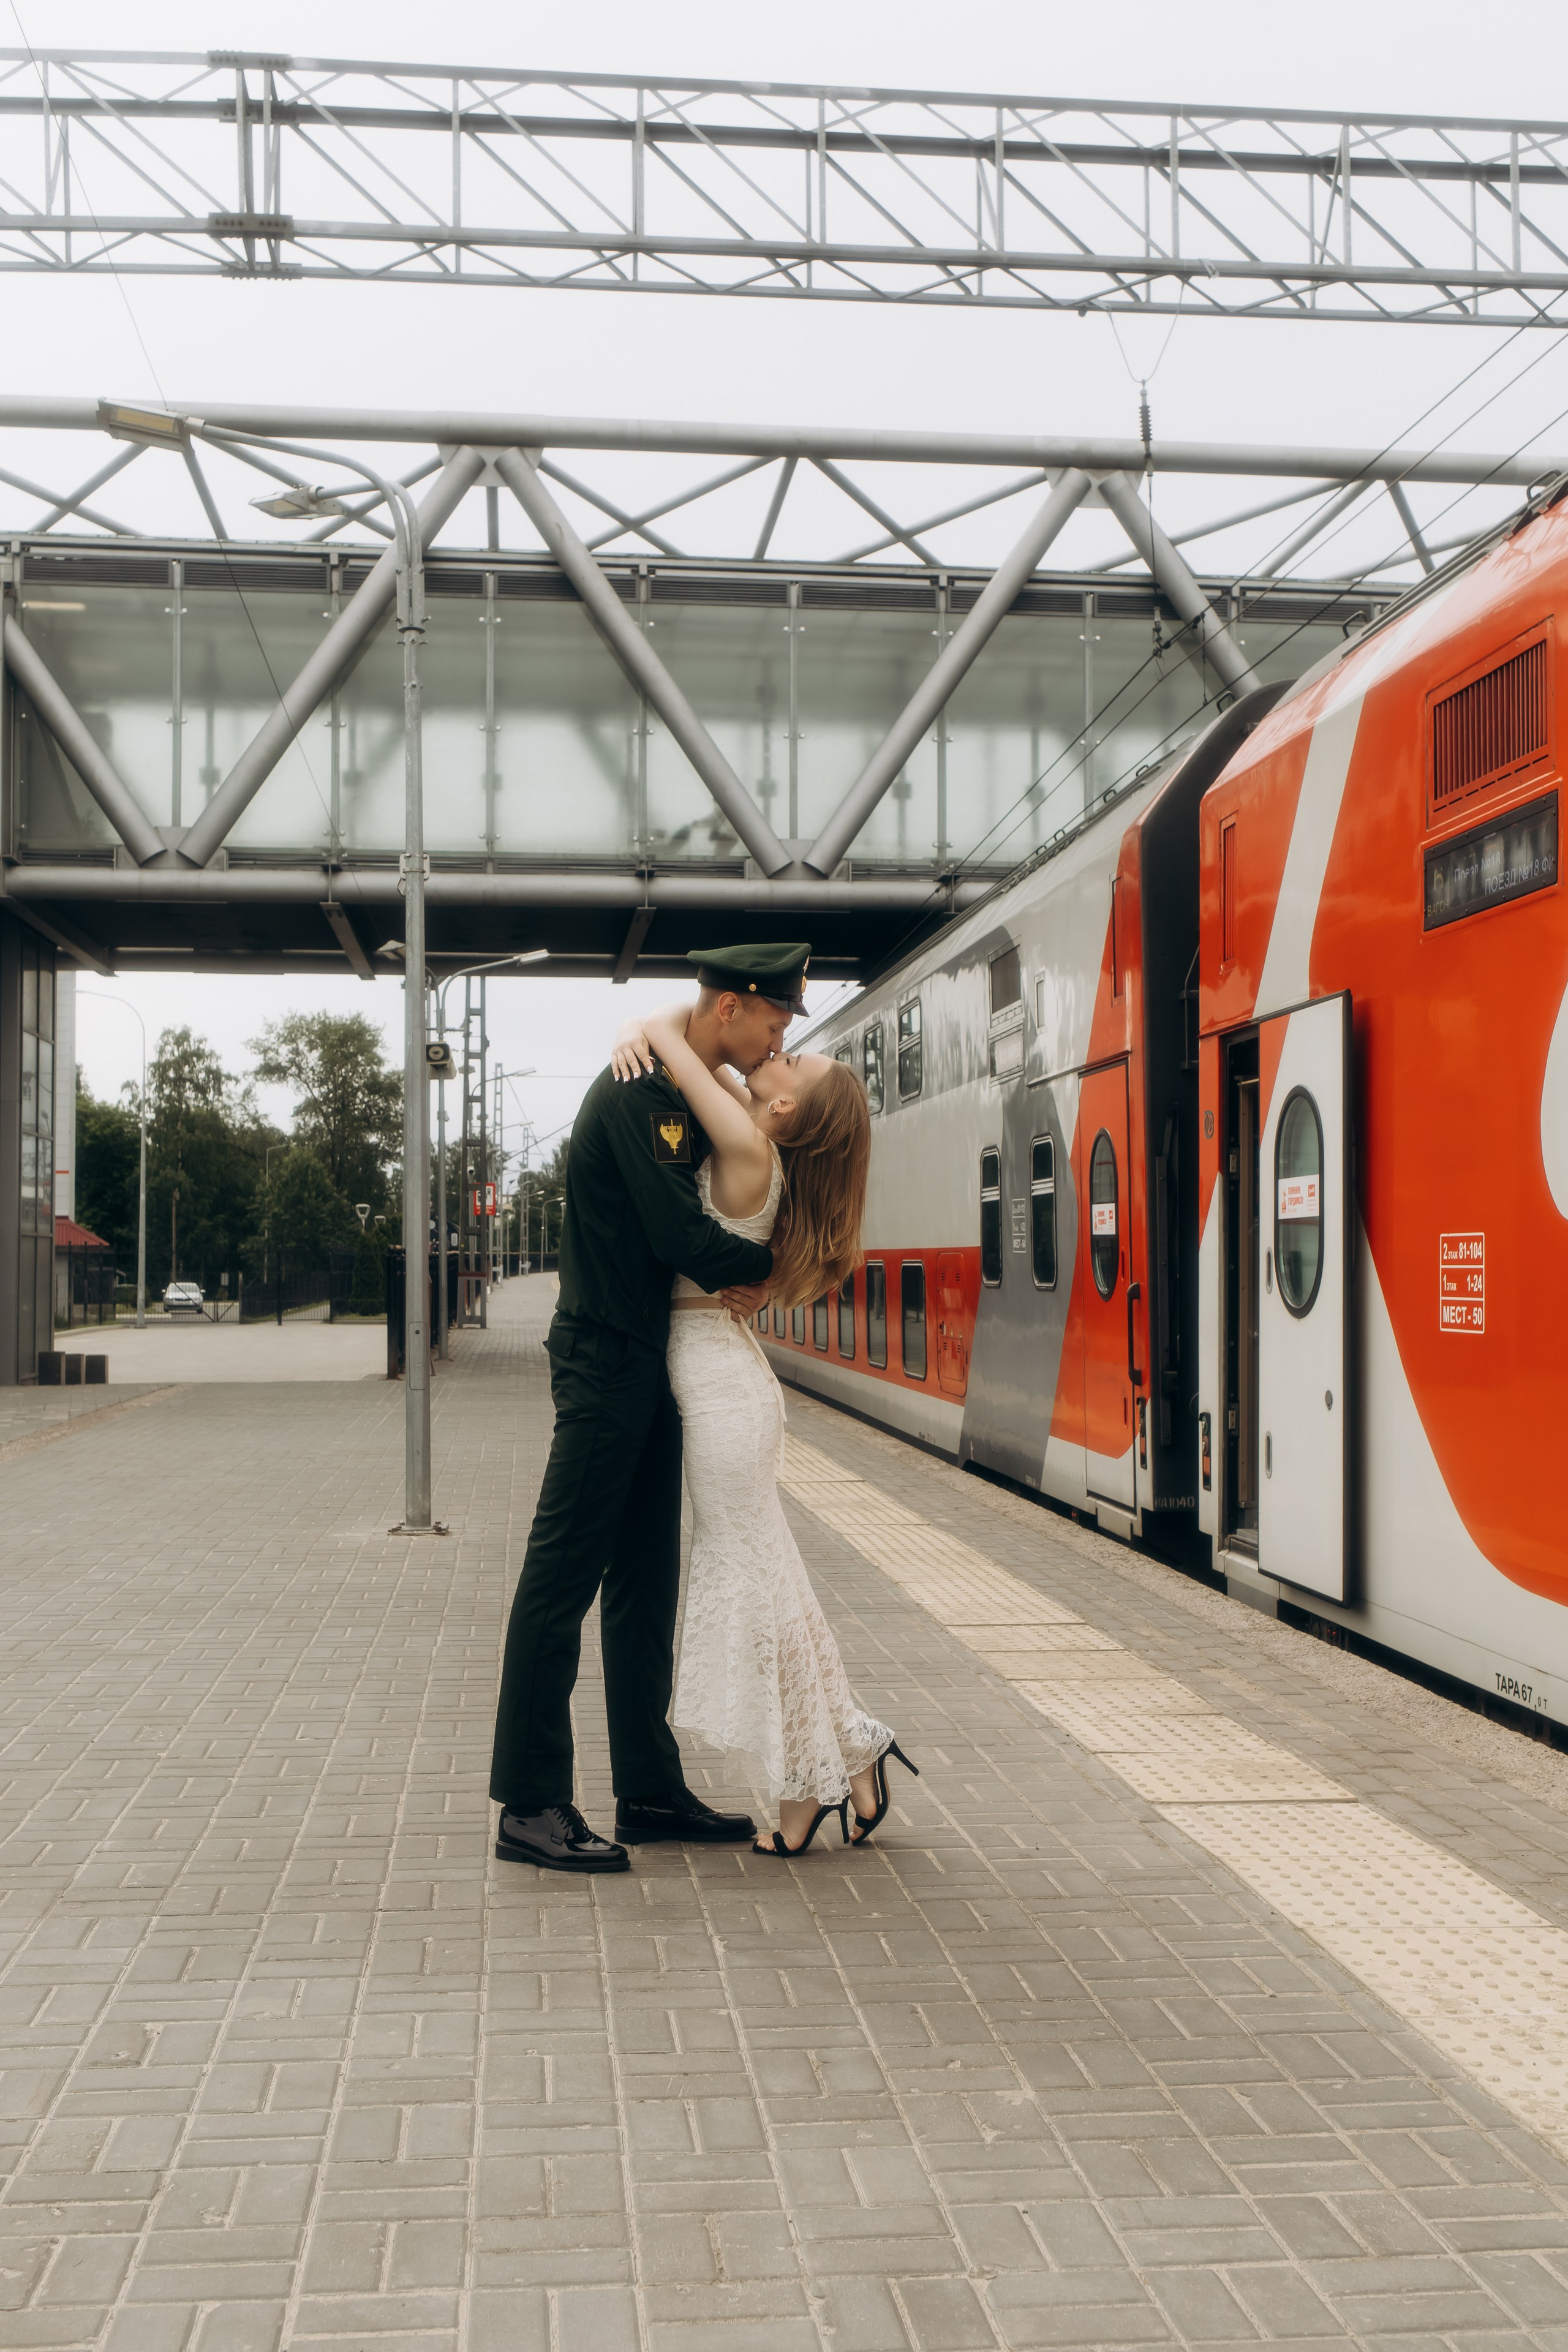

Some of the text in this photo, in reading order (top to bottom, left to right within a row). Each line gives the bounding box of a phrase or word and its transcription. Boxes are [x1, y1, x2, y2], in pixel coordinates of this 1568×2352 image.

[1485, 868, 1516, 895] ПОЕЗД
[1518, 859, 1539, 883] №18
[1427, 899, 1449, 918] ВАГОН
[1458, 1242, 1482, 1259] 81-104
[1466, 1274, 1482, 1292] 1-24
[1443, 1305, 1467, 1324] МЕСТ
[1472, 1307, 1482, 1325] 50
